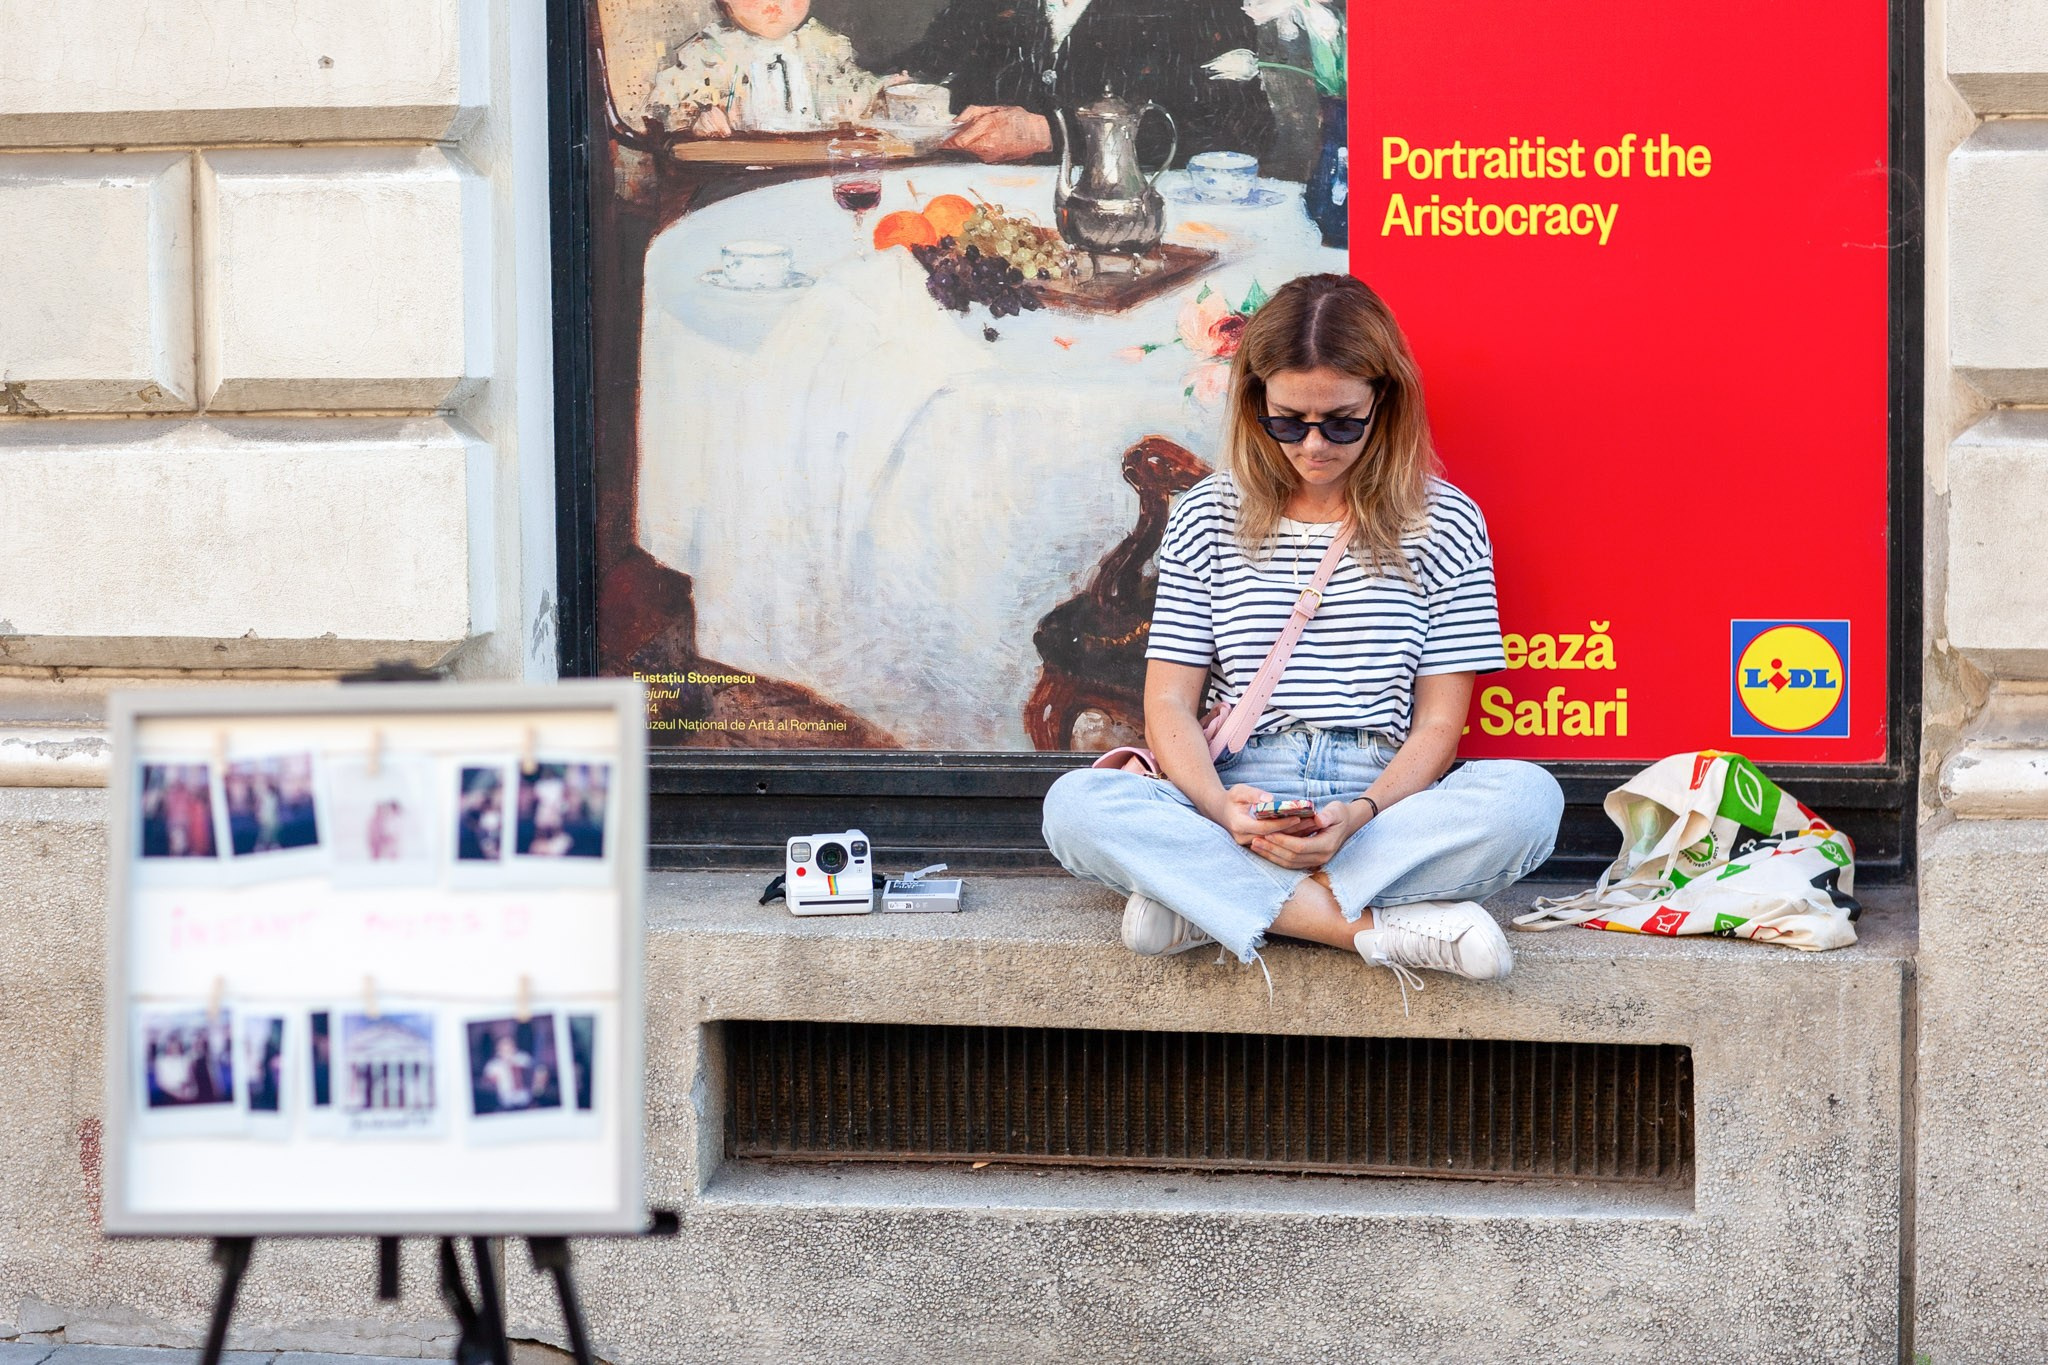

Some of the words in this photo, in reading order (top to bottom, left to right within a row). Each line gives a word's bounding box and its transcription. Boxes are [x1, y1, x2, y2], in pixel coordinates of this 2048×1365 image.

[1381, 136, 1586, 179] Portraitist
[1593, 133, 1637, 178] of
[1641, 133, 1712, 177] the
[1380, 193, 1619, 245] Aristocracy
[1501, 620, 1617, 670] ează
[632, 671, 685, 686] Eustațiu
[687, 671, 756, 684] Stoenescu
[640, 687, 681, 702] ejunul
[643, 702, 659, 715] 14
[642, 718, 676, 730] uzeul
[678, 718, 728, 732] Național
[730, 718, 746, 731] de
[748, 719, 775, 731] Artă
[777, 719, 788, 731] al
[790, 719, 847, 731] României
[1479, 685, 1628, 737] Safari
